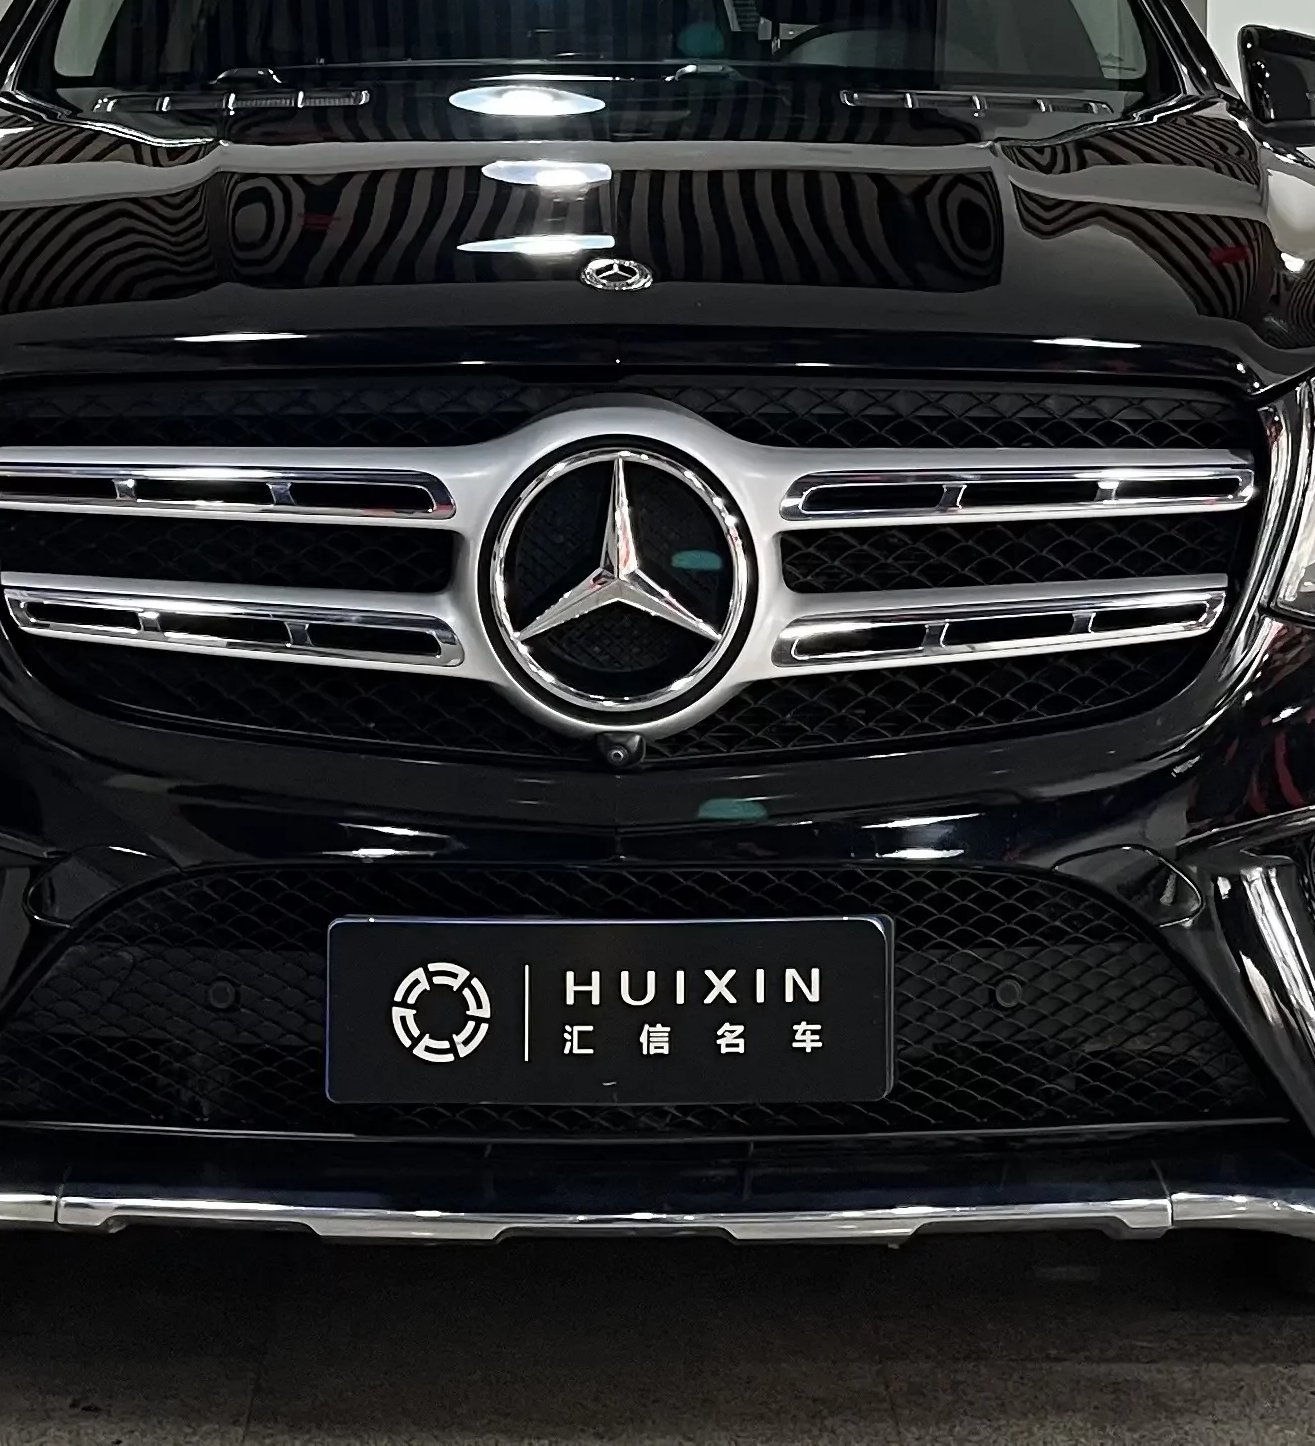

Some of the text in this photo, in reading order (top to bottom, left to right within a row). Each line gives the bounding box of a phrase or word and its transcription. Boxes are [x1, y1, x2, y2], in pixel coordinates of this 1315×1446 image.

[565, 967, 821, 1006] HUIXIN
[563, 1020, 823, 1056] 汇信名车
